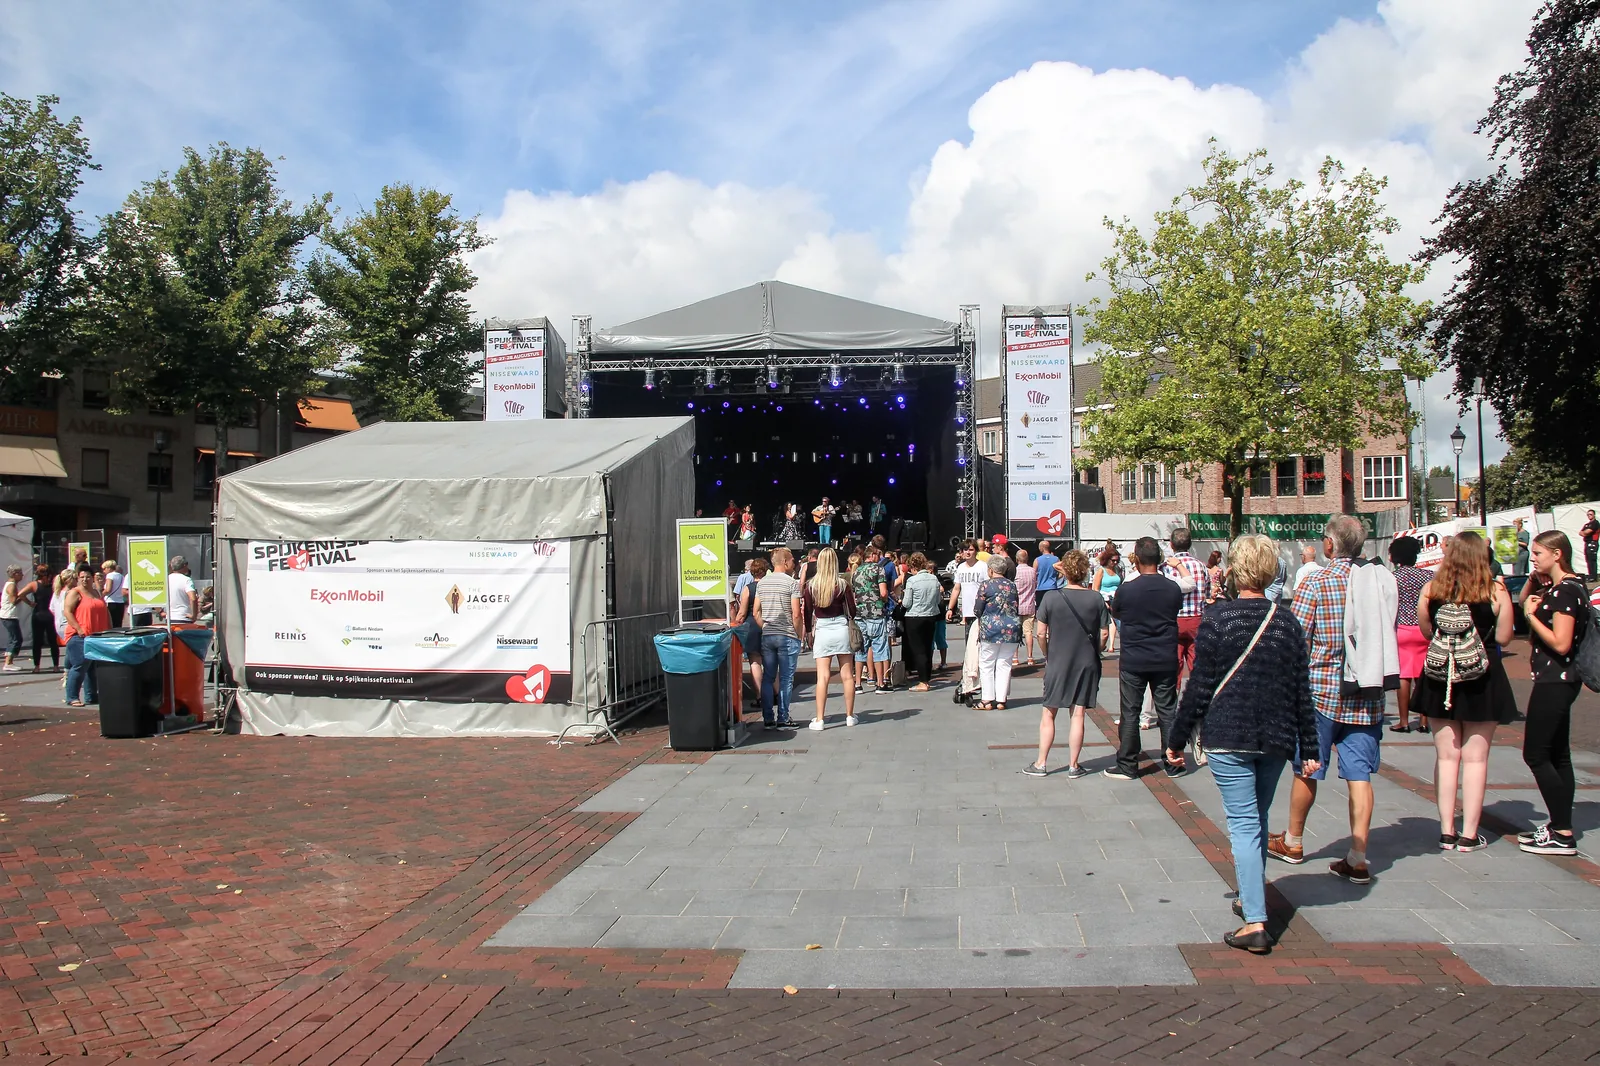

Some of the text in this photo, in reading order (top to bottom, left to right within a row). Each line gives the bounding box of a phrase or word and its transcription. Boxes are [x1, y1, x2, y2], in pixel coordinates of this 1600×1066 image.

[1015, 372, 1061, 381] ExxonMobil
[493, 382, 536, 392] ExxonMobil
[1027, 390, 1050, 404] STOEP
[504, 400, 525, 414] STOEP
[532, 541, 556, 557] STOEP
[268, 549, 356, 571] FETIVAL
[310, 589, 384, 604] ExxonMobil
[466, 594, 510, 603] JAGGER
[423, 632, 449, 642] GRADO
[496, 637, 538, 645] Nissewaard
[322, 674, 335, 682] Kijk
[345, 675, 414, 684] SpijkenisseFestival.nl
